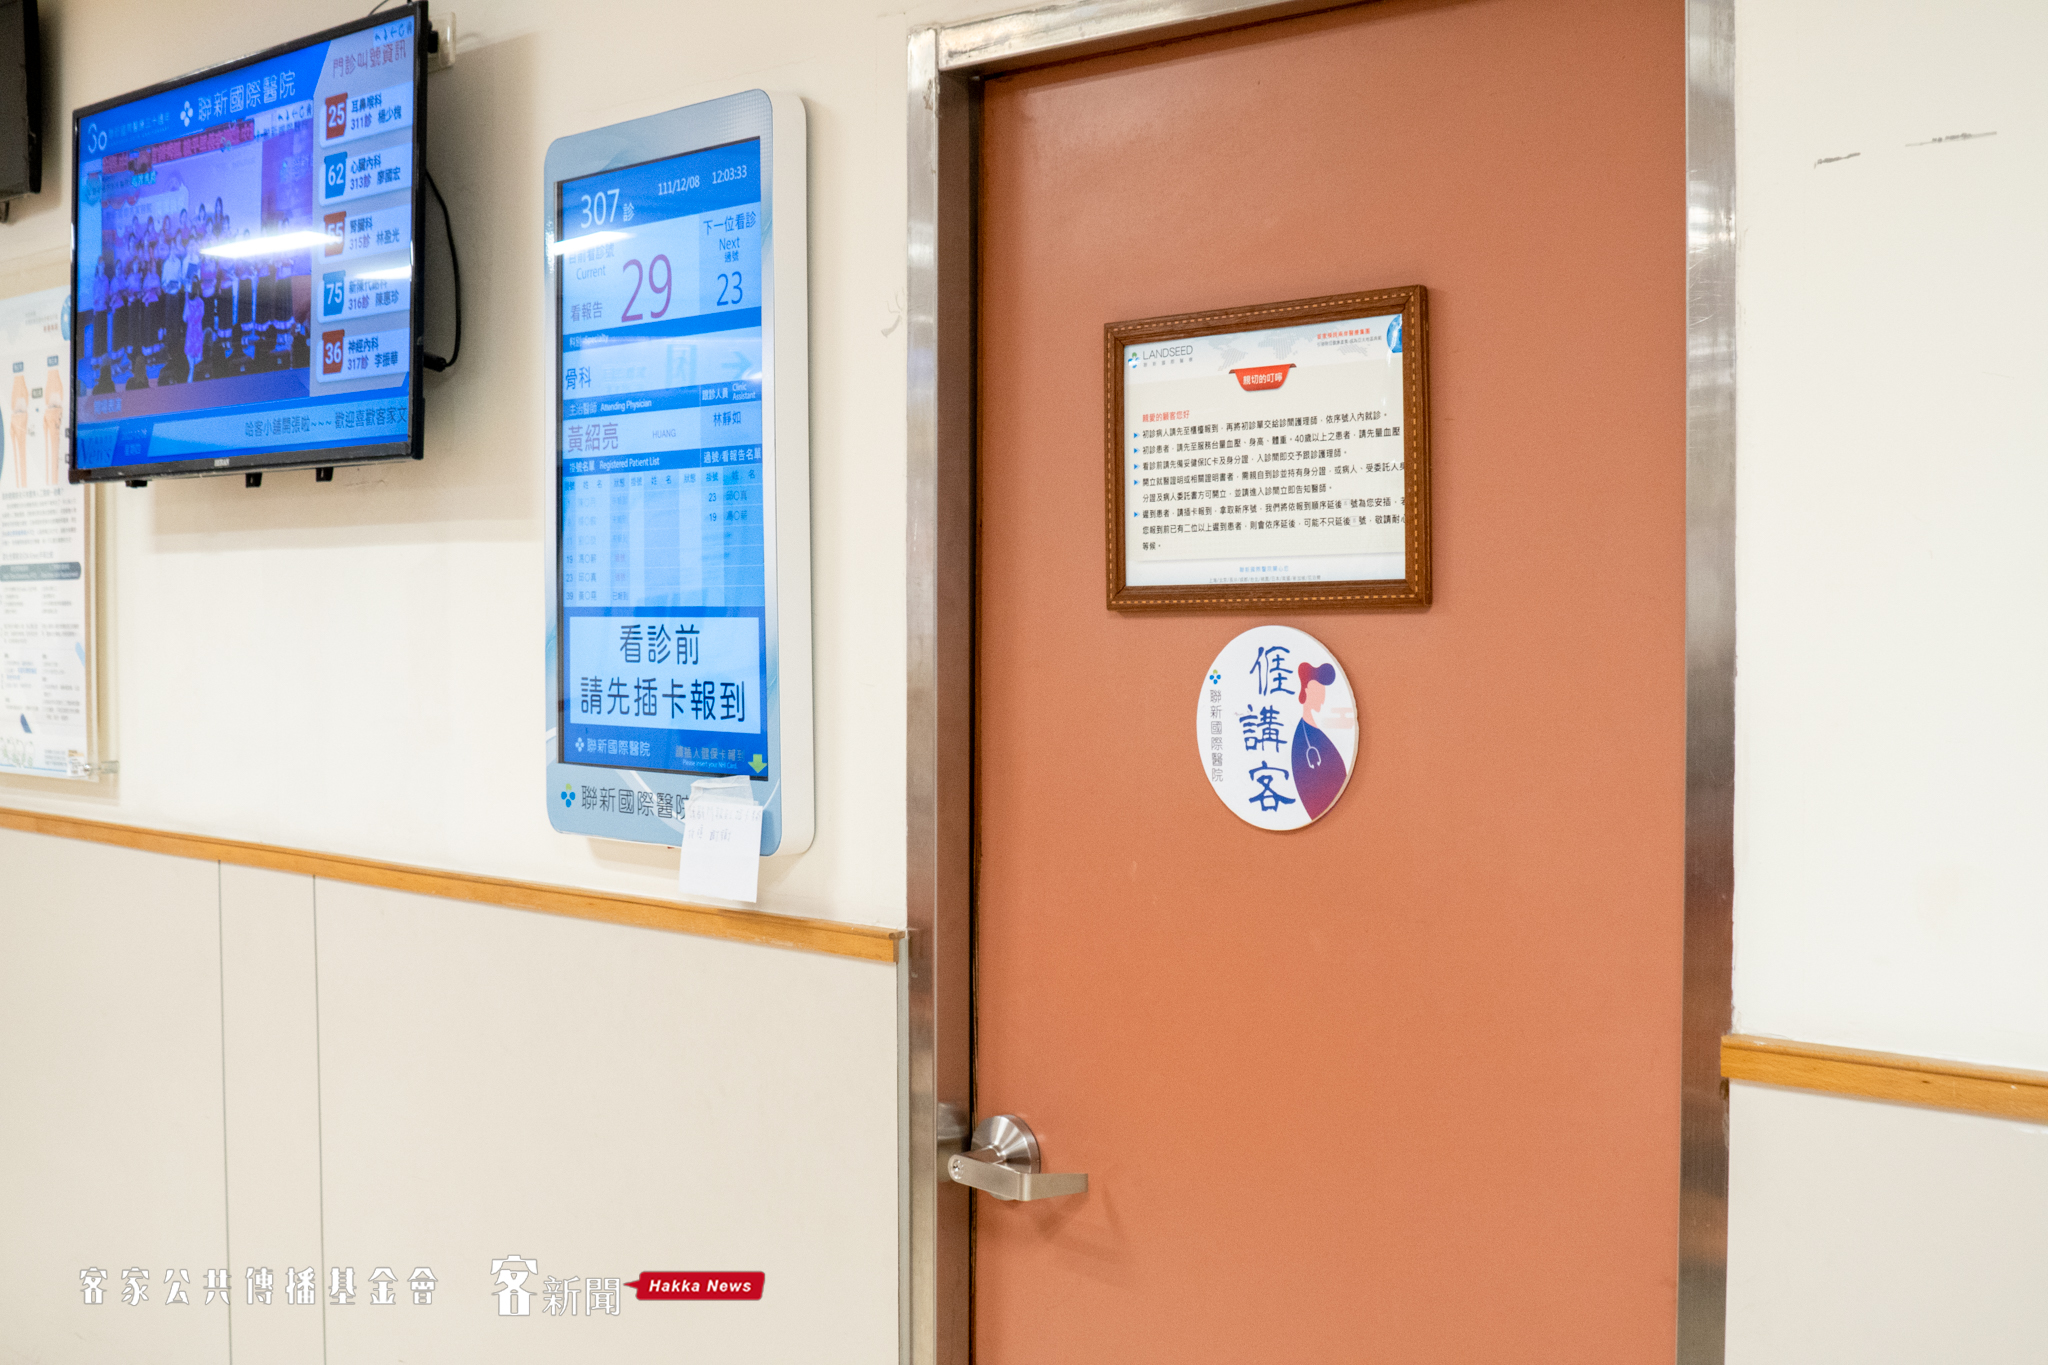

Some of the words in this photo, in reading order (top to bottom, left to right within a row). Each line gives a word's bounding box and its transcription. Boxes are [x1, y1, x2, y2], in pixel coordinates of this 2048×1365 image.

[333, 39, 406, 78] 門診叫號資訊
[198, 71, 296, 121] 聯新國際醫院
[351, 92, 382, 113] 耳鼻喉科
[328, 102, 345, 127] 25
[351, 154, 381, 173] 心臟內科
[328, 163, 344, 186] 62
[657, 175, 700, 196] 111/12/08
[712, 165, 748, 185] 12:03:33
[350, 216, 373, 233] 腎臟科
[703, 211, 756, 236] 下一位看診
[719, 237, 740, 251] Next
[576, 265, 606, 281] Current
[326, 283, 342, 304] 75
[621, 253, 673, 323] 29
[716, 271, 743, 306] 23
[570, 301, 603, 322] 看報告
[325, 341, 341, 364] 36
[348, 336, 379, 354] 神經內科
[1142, 345, 1193, 360] LANDSEED
[565, 365, 591, 391] 骨科
[1243, 372, 1283, 386] 親切的叮嚀
[732, 391, 756, 401] Assistant
[569, 401, 597, 417] 主治醫師
[600, 402, 626, 413] Attending
[626, 399, 652, 411] Physician
[1142, 410, 1190, 423] 親愛的顧客您好
[713, 411, 742, 427] 林靜如
[568, 422, 619, 453] 黃紹亮
[652, 429, 677, 439] HUANG
[599, 459, 628, 471] Registered
[629, 458, 649, 468] Patient
[649, 456, 660, 466] List
[708, 493, 716, 502] 23
[709, 512, 717, 522] 19
[566, 574, 573, 582] 23
[566, 592, 574, 601] 39
[619, 624, 700, 665] 看診前
[580, 676, 745, 722] 請先插卡報到
[1210, 689, 1224, 782] 聯新國際醫院
[587, 737, 650, 757] 聯新國際醫院
